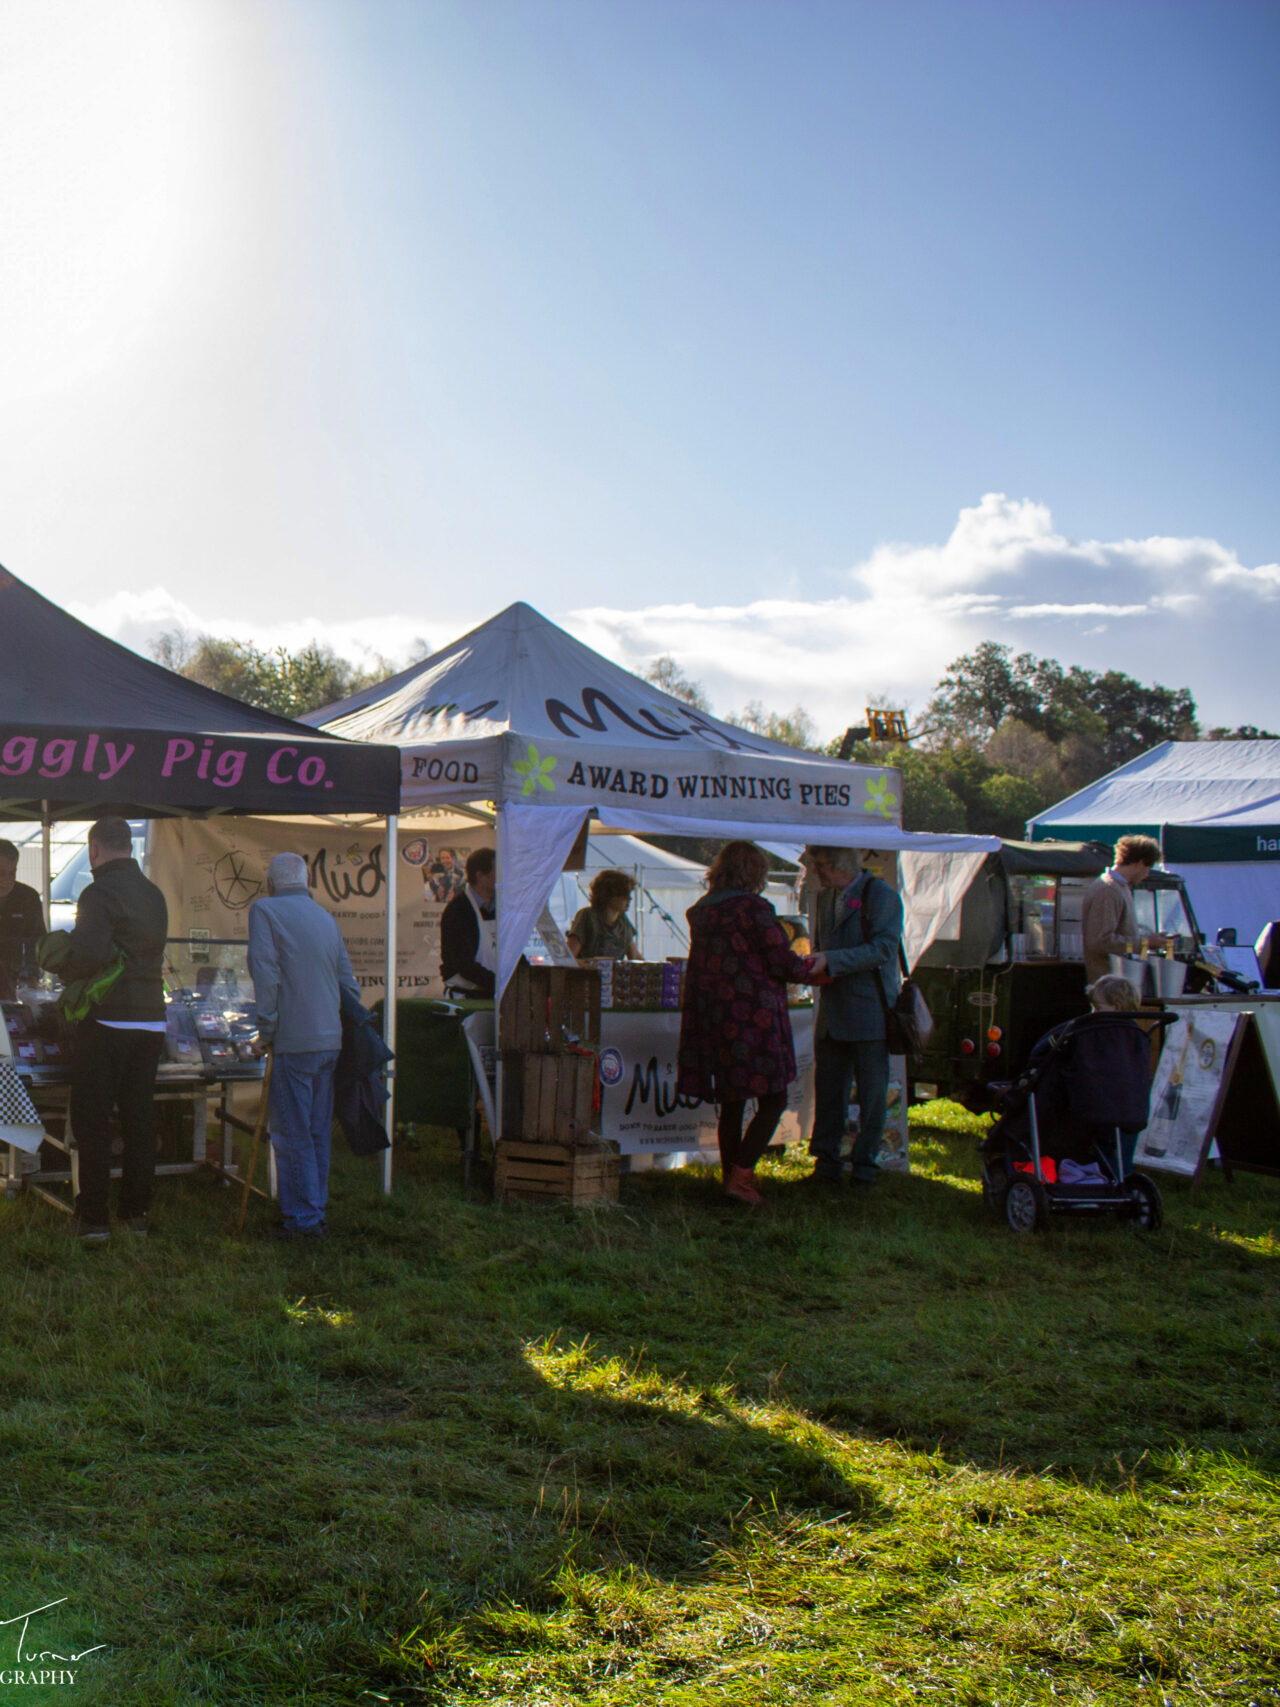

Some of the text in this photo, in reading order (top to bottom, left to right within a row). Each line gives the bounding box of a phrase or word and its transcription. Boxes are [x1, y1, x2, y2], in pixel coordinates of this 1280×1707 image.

[161, 738, 247, 788] Pig
[266, 747, 334, 789] Co.
[412, 757, 479, 784] FOOD
[568, 761, 851, 806] AWARD WINNING PIES
[1257, 835, 1280, 851] ha
